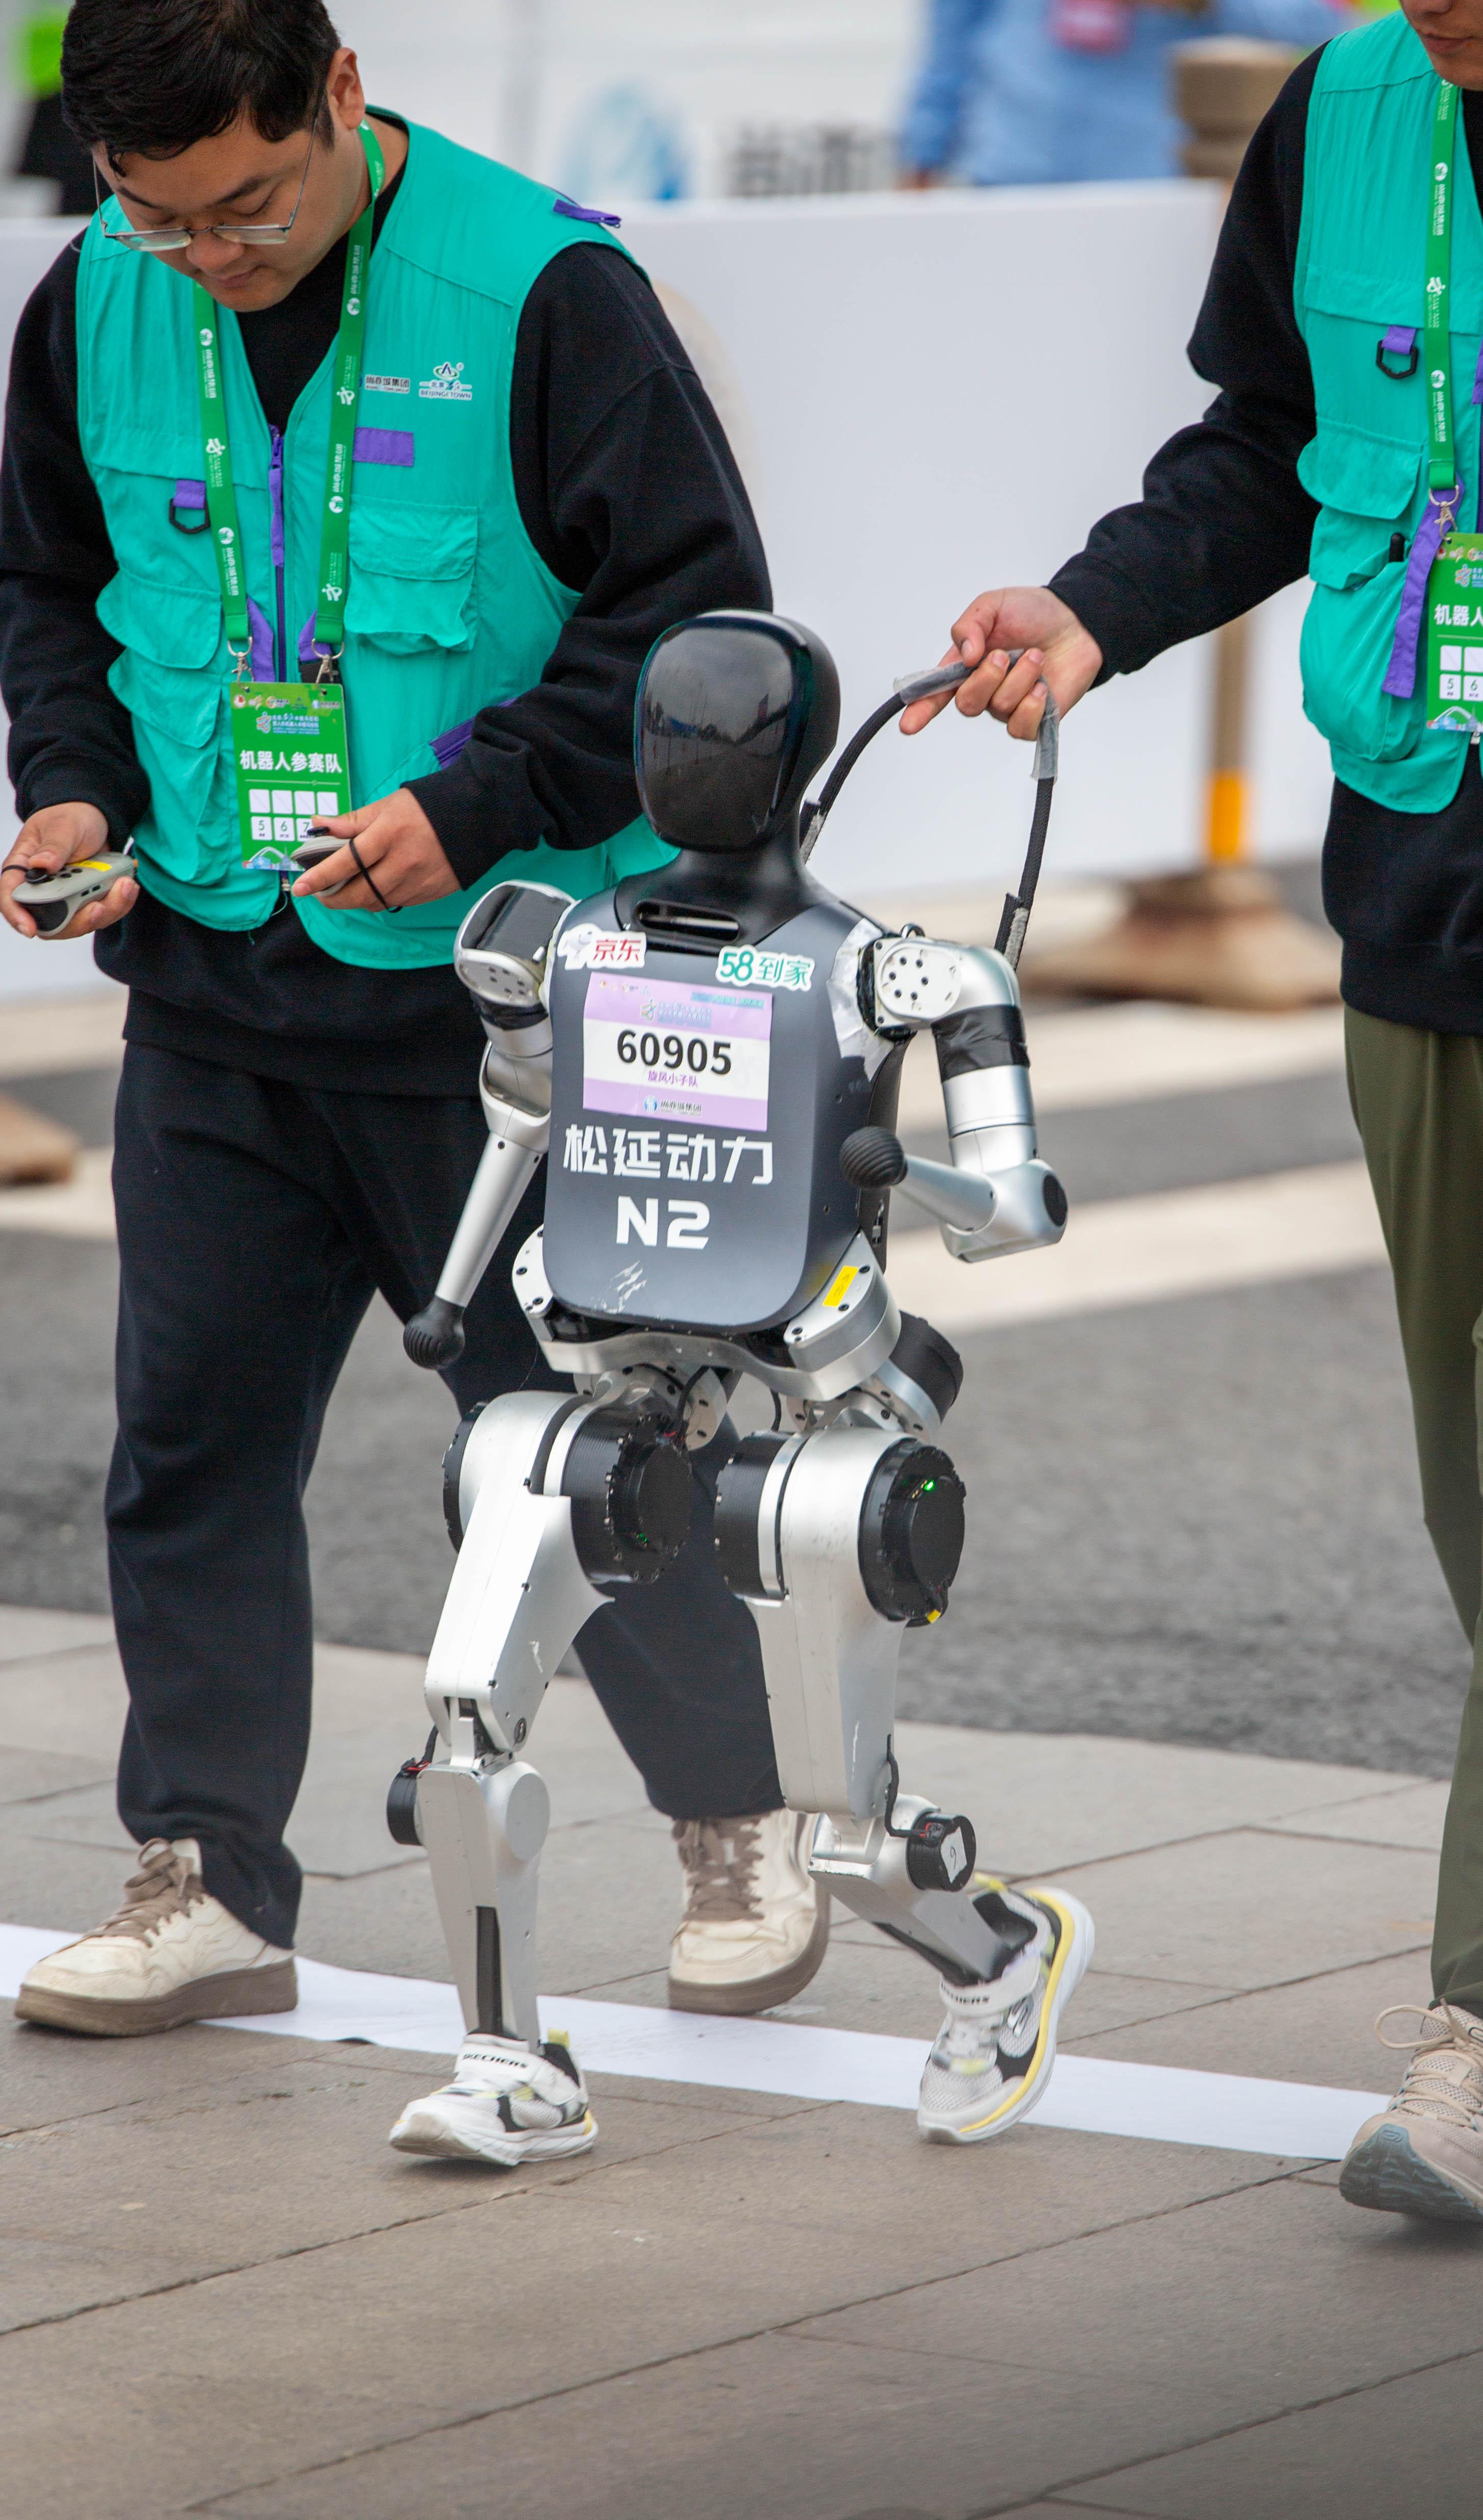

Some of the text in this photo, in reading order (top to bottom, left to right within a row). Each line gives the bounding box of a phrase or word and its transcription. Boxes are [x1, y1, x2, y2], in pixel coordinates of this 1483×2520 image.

[240, 750, 343, 773] 机器人参赛队
[259, 820, 265, 831] 5
[280, 821, 288, 831] 6
[594, 938, 641, 960] 京东
[720, 950, 811, 986] 58到家
[617, 1030, 731, 1075] 60905
[563, 1124, 773, 1184] 松延动力
[616, 1196, 710, 1250] N2
